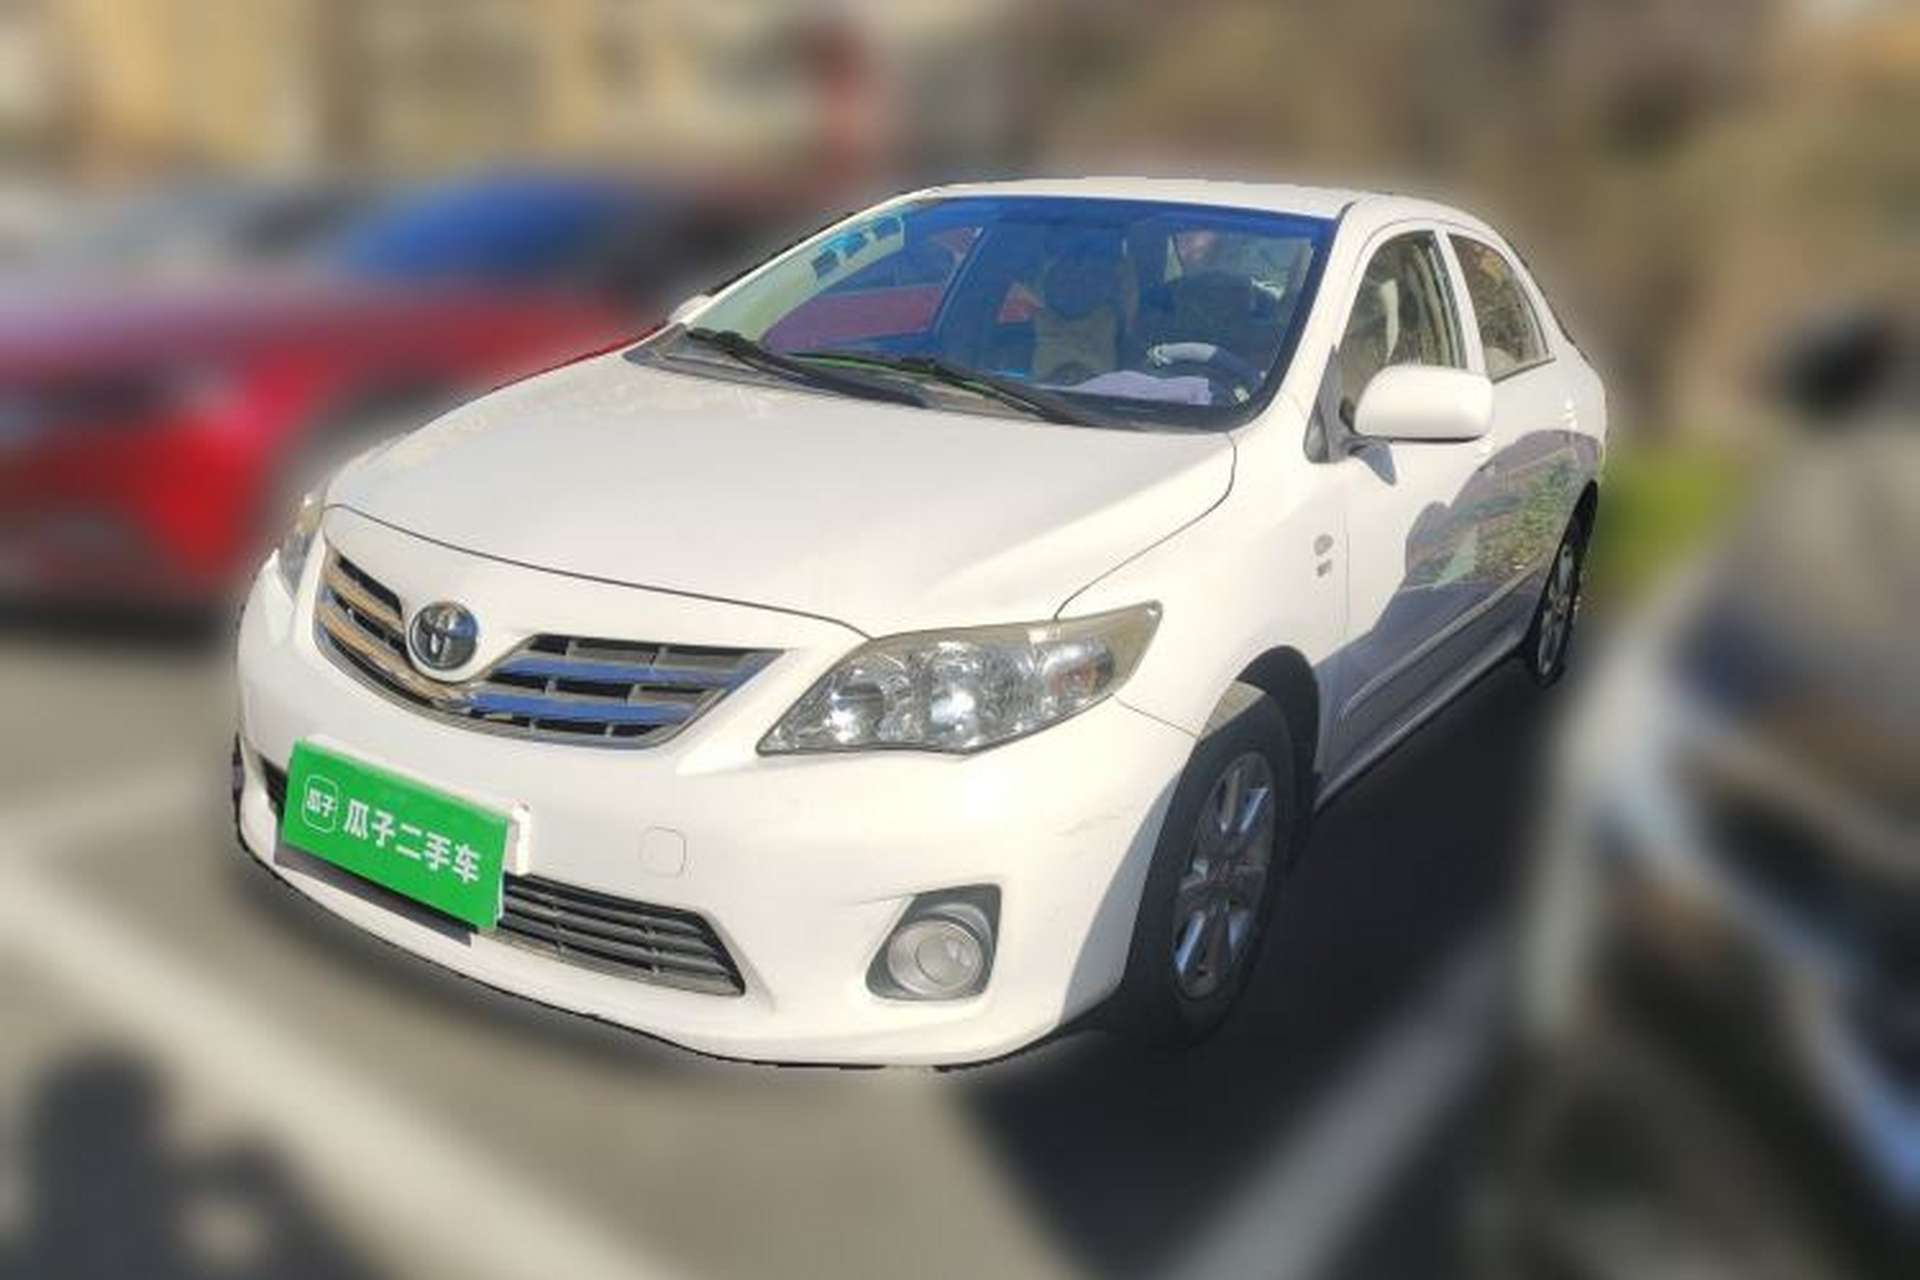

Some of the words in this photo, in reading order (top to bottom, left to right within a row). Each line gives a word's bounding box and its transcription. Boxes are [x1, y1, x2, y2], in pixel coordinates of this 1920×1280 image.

[343, 798, 481, 884] 瓜子二手车
